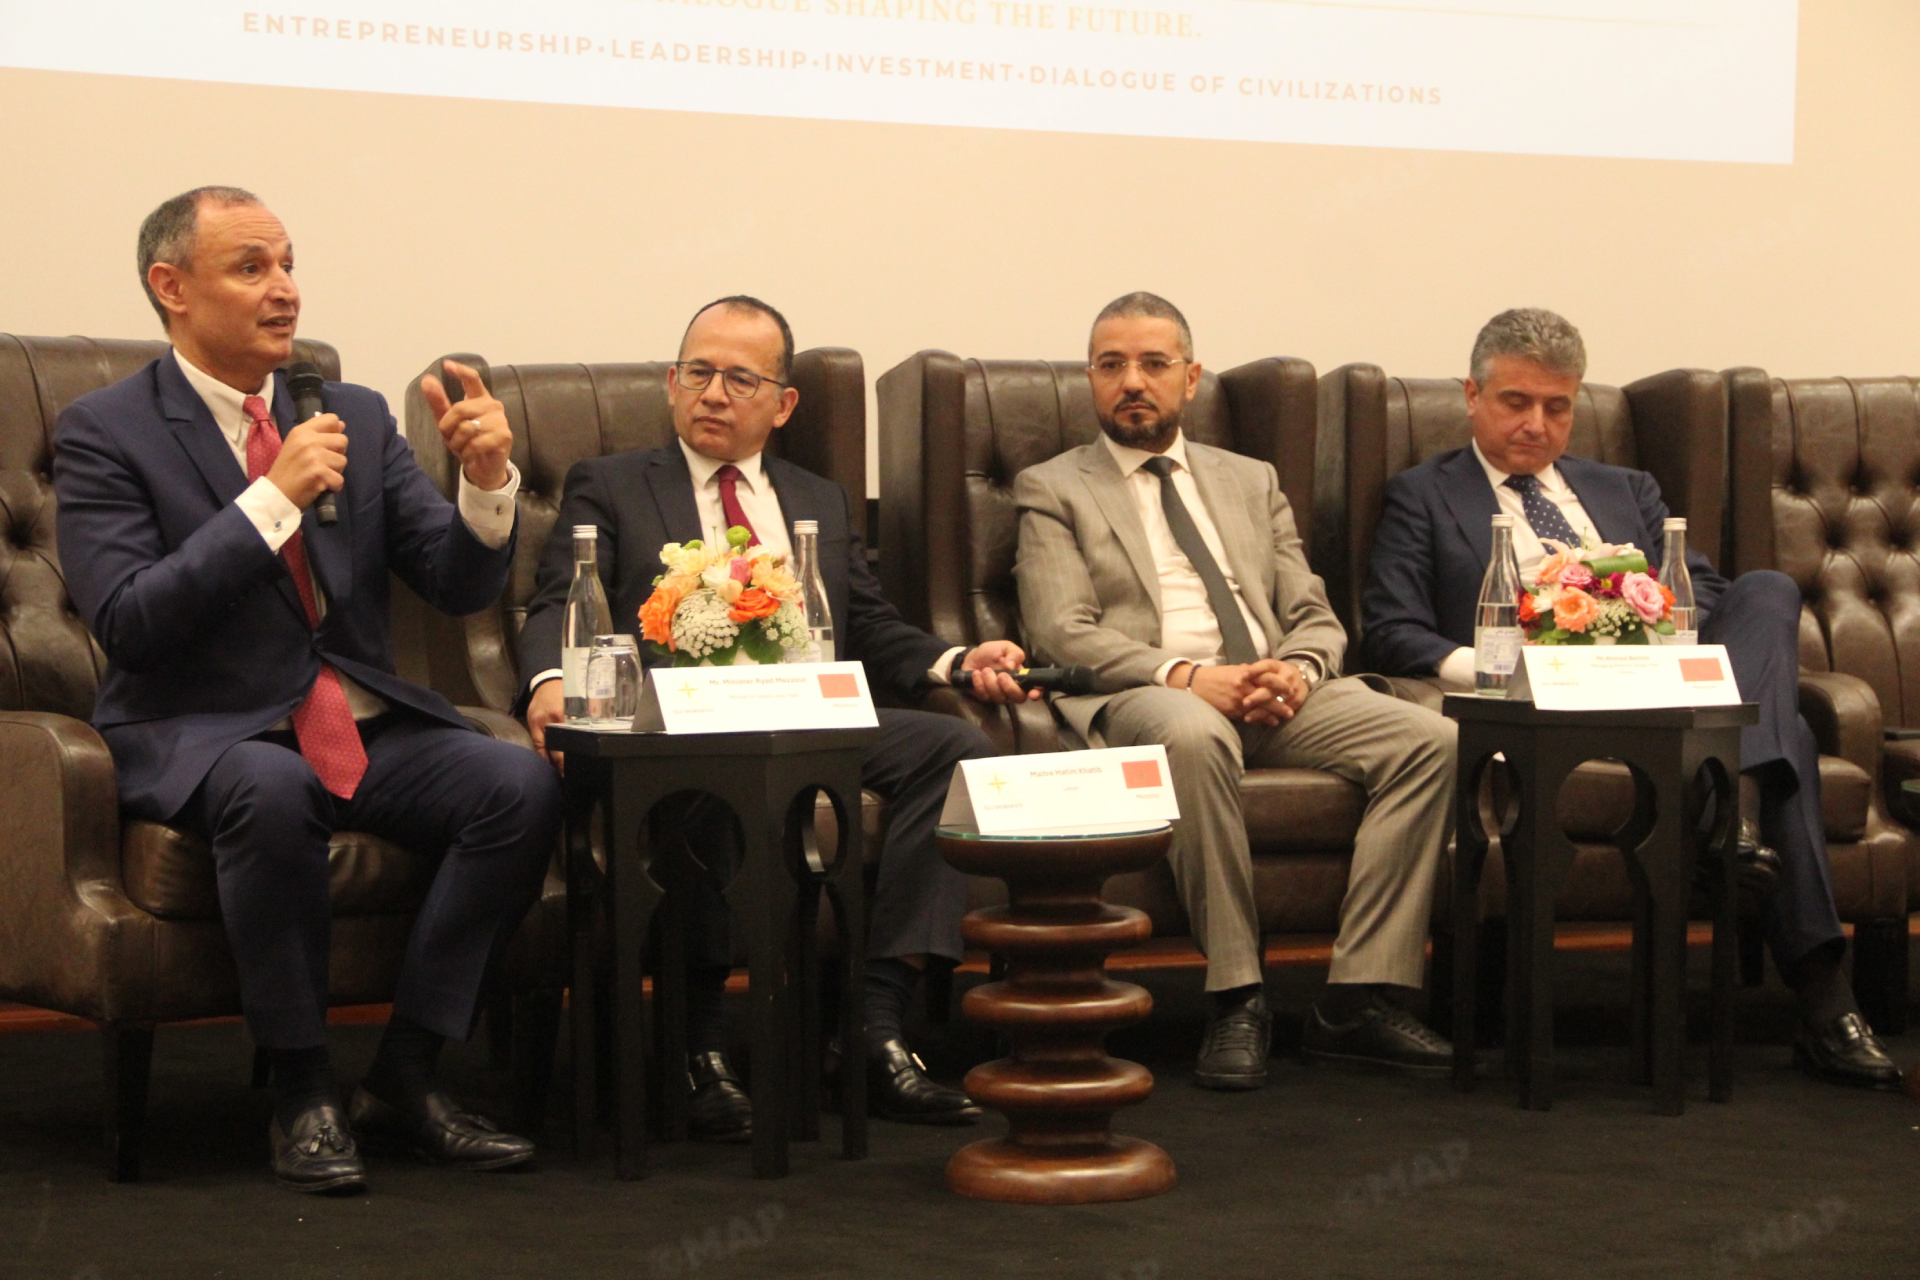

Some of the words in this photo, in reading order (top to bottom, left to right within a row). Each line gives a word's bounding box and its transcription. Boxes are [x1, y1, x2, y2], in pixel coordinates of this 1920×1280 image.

[825, 0, 977, 24] SHAPING
[989, 1, 1055, 30] THE
[1067, 6, 1204, 38] FUTURE.
[1189, 75, 1225, 95] OF
[1238, 77, 1442, 105] CIVILIZATIONS
